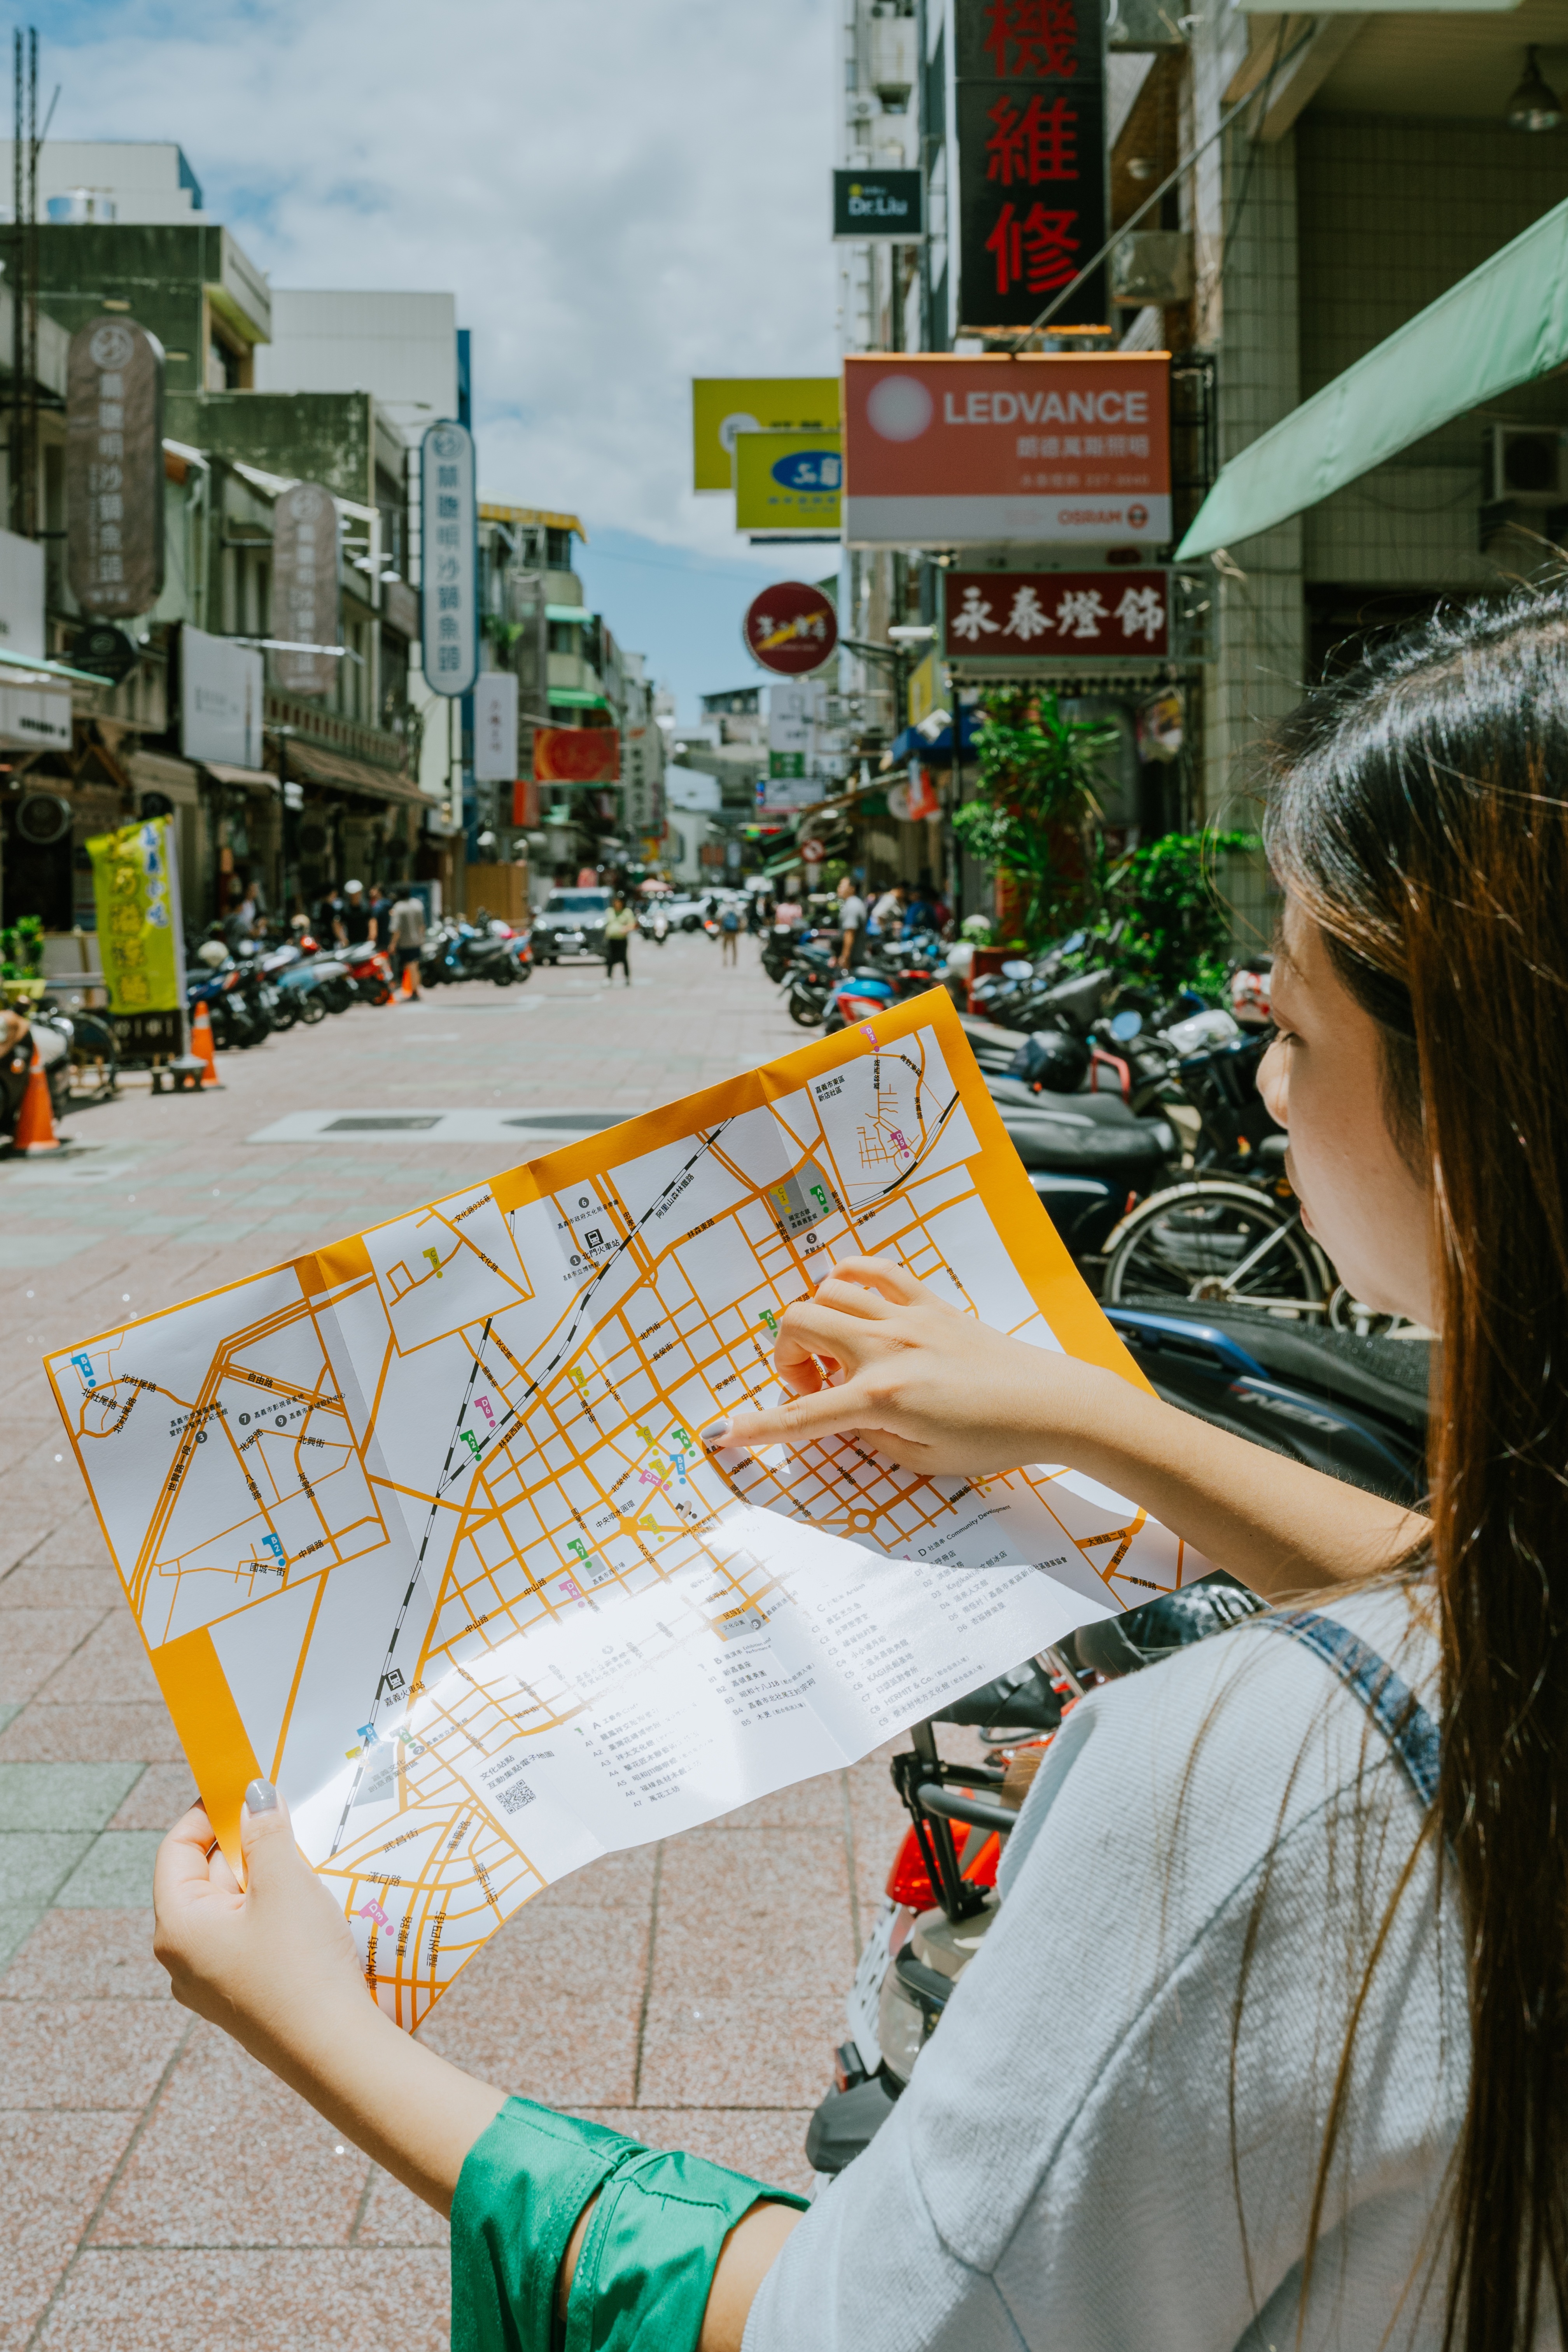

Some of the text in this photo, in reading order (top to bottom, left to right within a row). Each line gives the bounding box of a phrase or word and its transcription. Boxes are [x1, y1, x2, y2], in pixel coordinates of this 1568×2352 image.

[944, 389, 1149, 425] LEDVANCE
[951, 585, 1165, 643] 永泰燈飾
[815, 1075, 845, 1094] 嘉義市東區
[818, 1086, 842, 1102] 新店社區
[656, 1173, 695, 1218] 阿里山森林鐵路
[831, 1190, 845, 1213] 新生路
[454, 1194, 491, 1223] 文化路936巷
[558, 1199, 619, 1229] 嘉義市政府文化局音樂廳
[788, 1208, 810, 1222] 國定古蹟
[687, 1218, 715, 1239] 林森東路
[775, 1220, 791, 1243] 維新路
[582, 1239, 620, 1260] 北門火車站
[478, 1253, 498, 1272] 文化路
[563, 1261, 600, 1281] 嘉義市立博物館
[640, 1321, 661, 1340] 北門街
[496, 1339, 513, 1360] 文化路
[653, 1342, 673, 1361] 長榮街
[753, 1344, 769, 1367] 和平路
[120, 1374, 157, 1393] 北社尾路
[247, 1373, 273, 1388] 自由路
[482, 1366, 498, 1388] 國華街
[715, 1374, 737, 1391] 安樂街
[81, 1388, 117, 1410] 北社尾路
[605, 1379, 621, 1402] 成仁街
[741, 1385, 762, 1401] 中山路
[113, 1397, 137, 1434] 北社尾路
[170, 1401, 222, 1428] 嘉義市世賢圖書館
[254, 1393, 305, 1419] 嘉義市影視音基地
[289, 1392, 346, 1420] 嘉義市區域設計中心
[240, 1428, 264, 1452] 北安路
[298, 1435, 325, 1448] 北興街
[499, 1420, 523, 1449] 林森西路
[167, 1445, 191, 1491] 世賢路一段
[732, 1458, 753, 1475] 公明路
[770, 1458, 792, 1474] 中正路
[245, 1474, 262, 1500] 八德路
[298, 1473, 315, 1499] 友愛路
[611, 1472, 630, 1493] 北榮街
[571, 1508, 587, 1530] 國華街
[596, 1500, 635, 1529] 中央噴水圓環
[946, 1519, 978, 1540] Community
[978, 1505, 1012, 1520] Development
[1087, 1530, 1128, 1547] 大雅路二段
[298, 1540, 324, 1559] 中興路
[638, 1544, 655, 1564] 文化路
[250, 1563, 286, 1577] 國城一街
[592, 1562, 625, 1586] 嘉義市西市場
[524, 1578, 547, 1596] 中山路
[923, 1579, 933, 1587] D2
[1129, 1576, 1157, 1590] 潭頂路
[931, 1590, 942, 1598] D3
[723, 1606, 745, 1620] 民族路
[940, 1602, 950, 1610] D4
[465, 1615, 489, 1633] 中山路
[723, 1619, 746, 1631] 文化公園
[957, 1624, 968, 1633] D6
[383, 1680, 425, 1708] 嘉義火車站
[724, 1696, 735, 1704] B3
[733, 1708, 744, 1716] B4
[741, 1718, 751, 1727] B5
[480, 1755, 515, 1781] 文化站點
[382, 1828, 418, 1853] 武昌街
[447, 1820, 472, 1850] 重慶路
[366, 1871, 402, 1888] 漢口路
[472, 1862, 499, 1906] 福州二街
[396, 1916, 413, 1958] 重慶路
[427, 1911, 447, 1968] 福州四街
[366, 1936, 379, 1991] 福州六街
